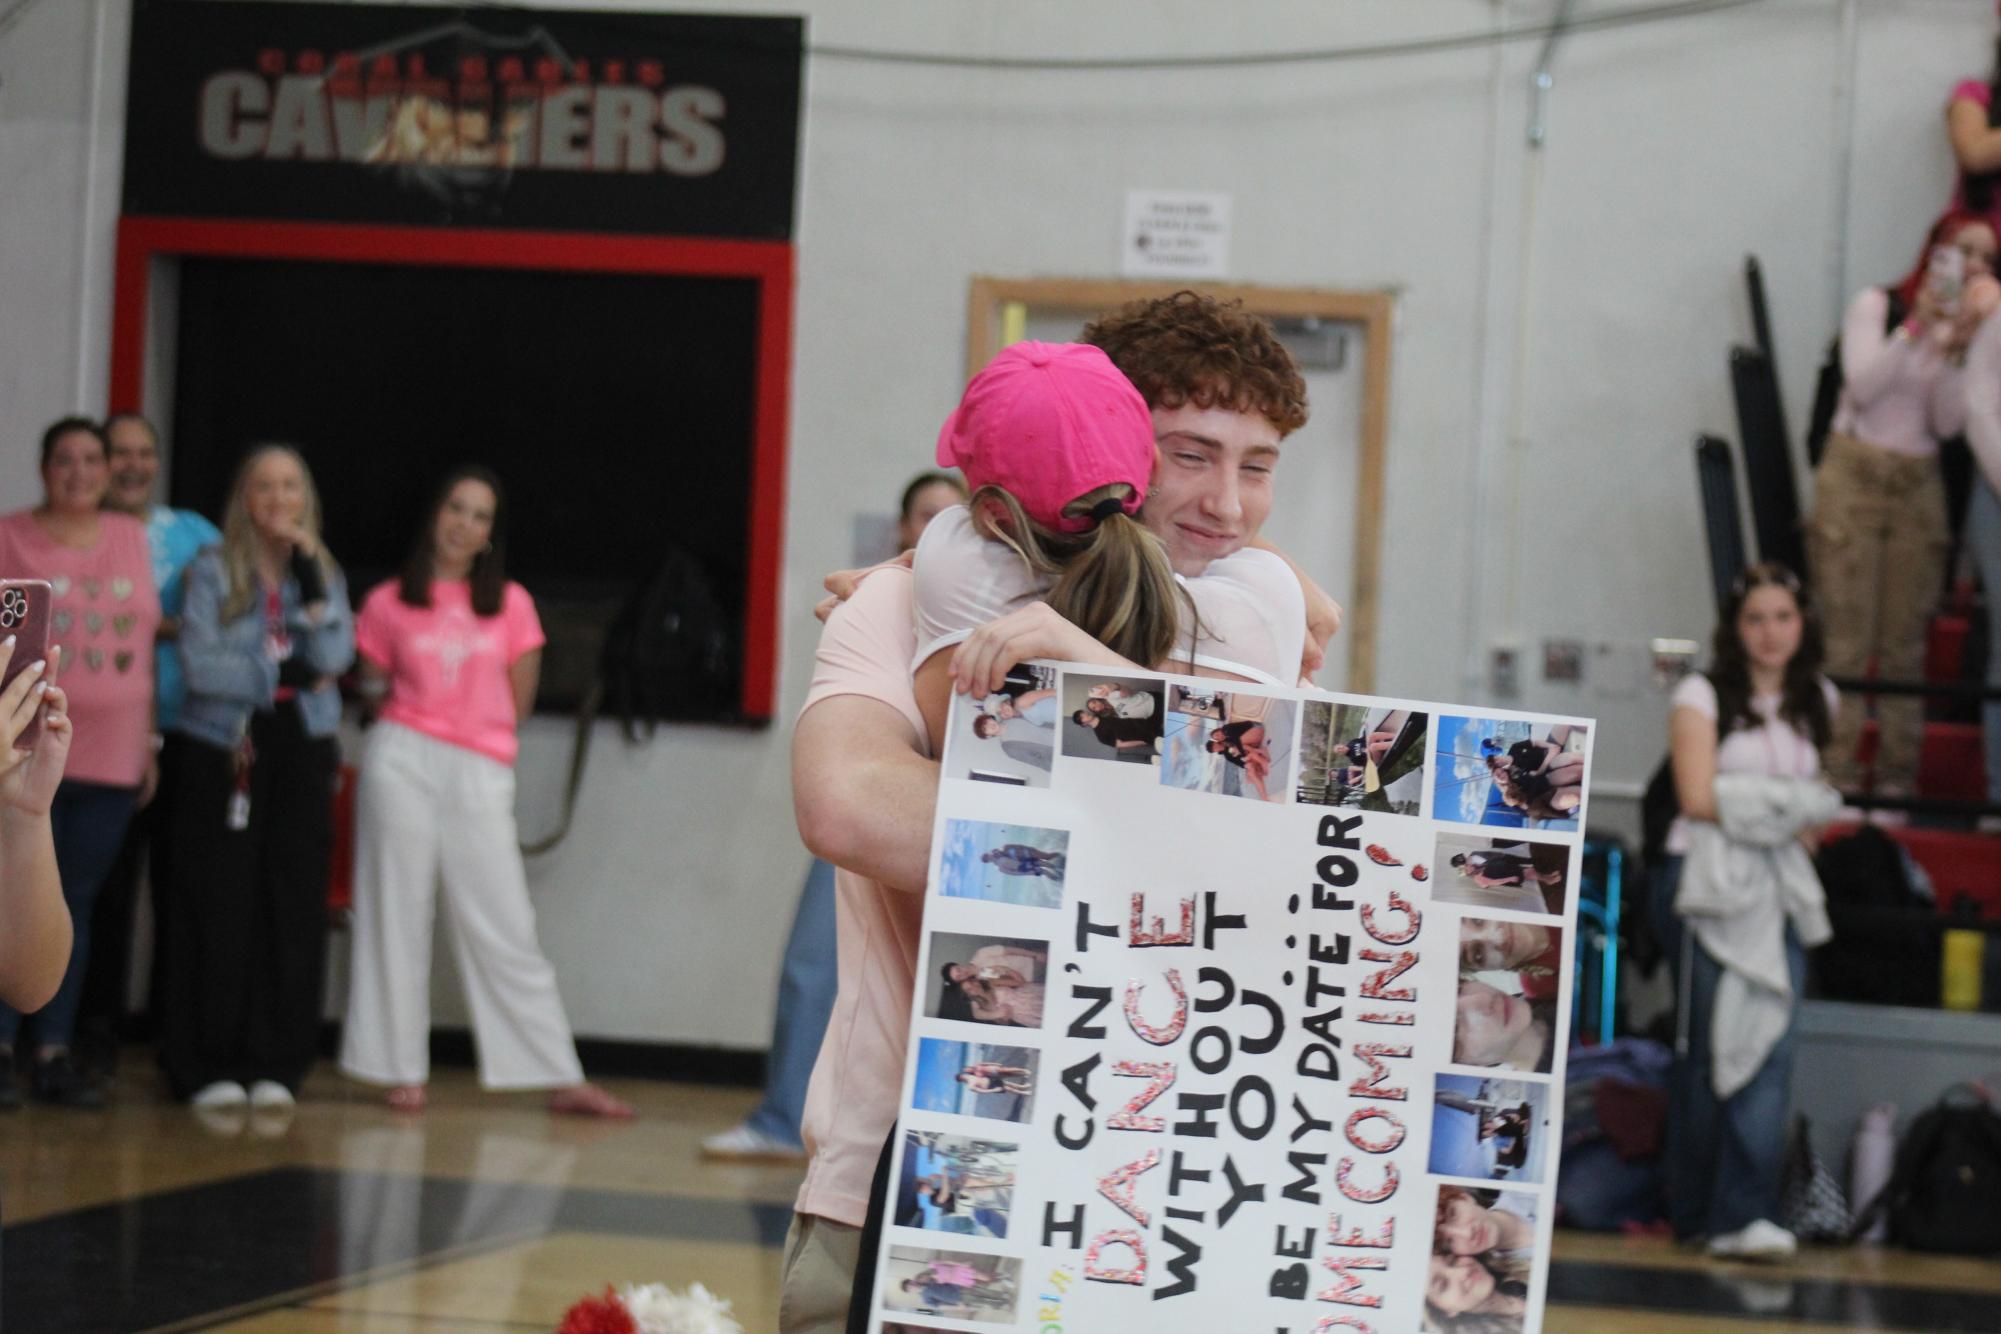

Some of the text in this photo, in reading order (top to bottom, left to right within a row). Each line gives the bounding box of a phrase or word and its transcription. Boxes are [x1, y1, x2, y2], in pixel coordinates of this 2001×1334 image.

[1054, 901, 1120, 1150] CAN'T
[1084, 891, 1197, 1286] DANCE
[1153, 891, 1248, 1300] WITHOUT
[1269, 814, 1363, 1300] BE MY DATE FOR
